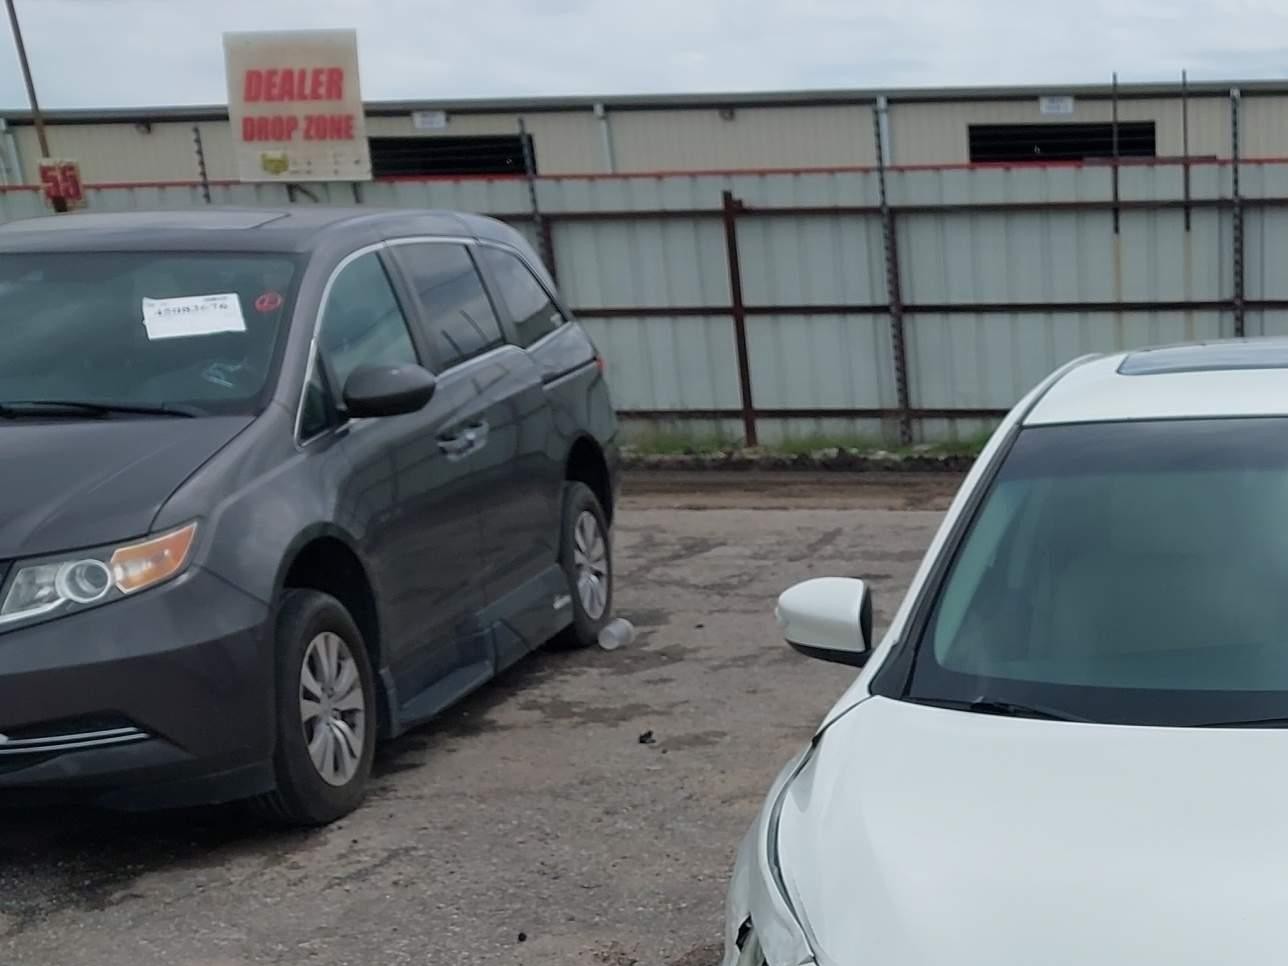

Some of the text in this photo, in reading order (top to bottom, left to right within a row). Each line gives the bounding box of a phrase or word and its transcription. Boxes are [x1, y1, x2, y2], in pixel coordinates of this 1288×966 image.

[244, 67, 344, 102] DEALER
[242, 113, 354, 142] DROP ZONE
